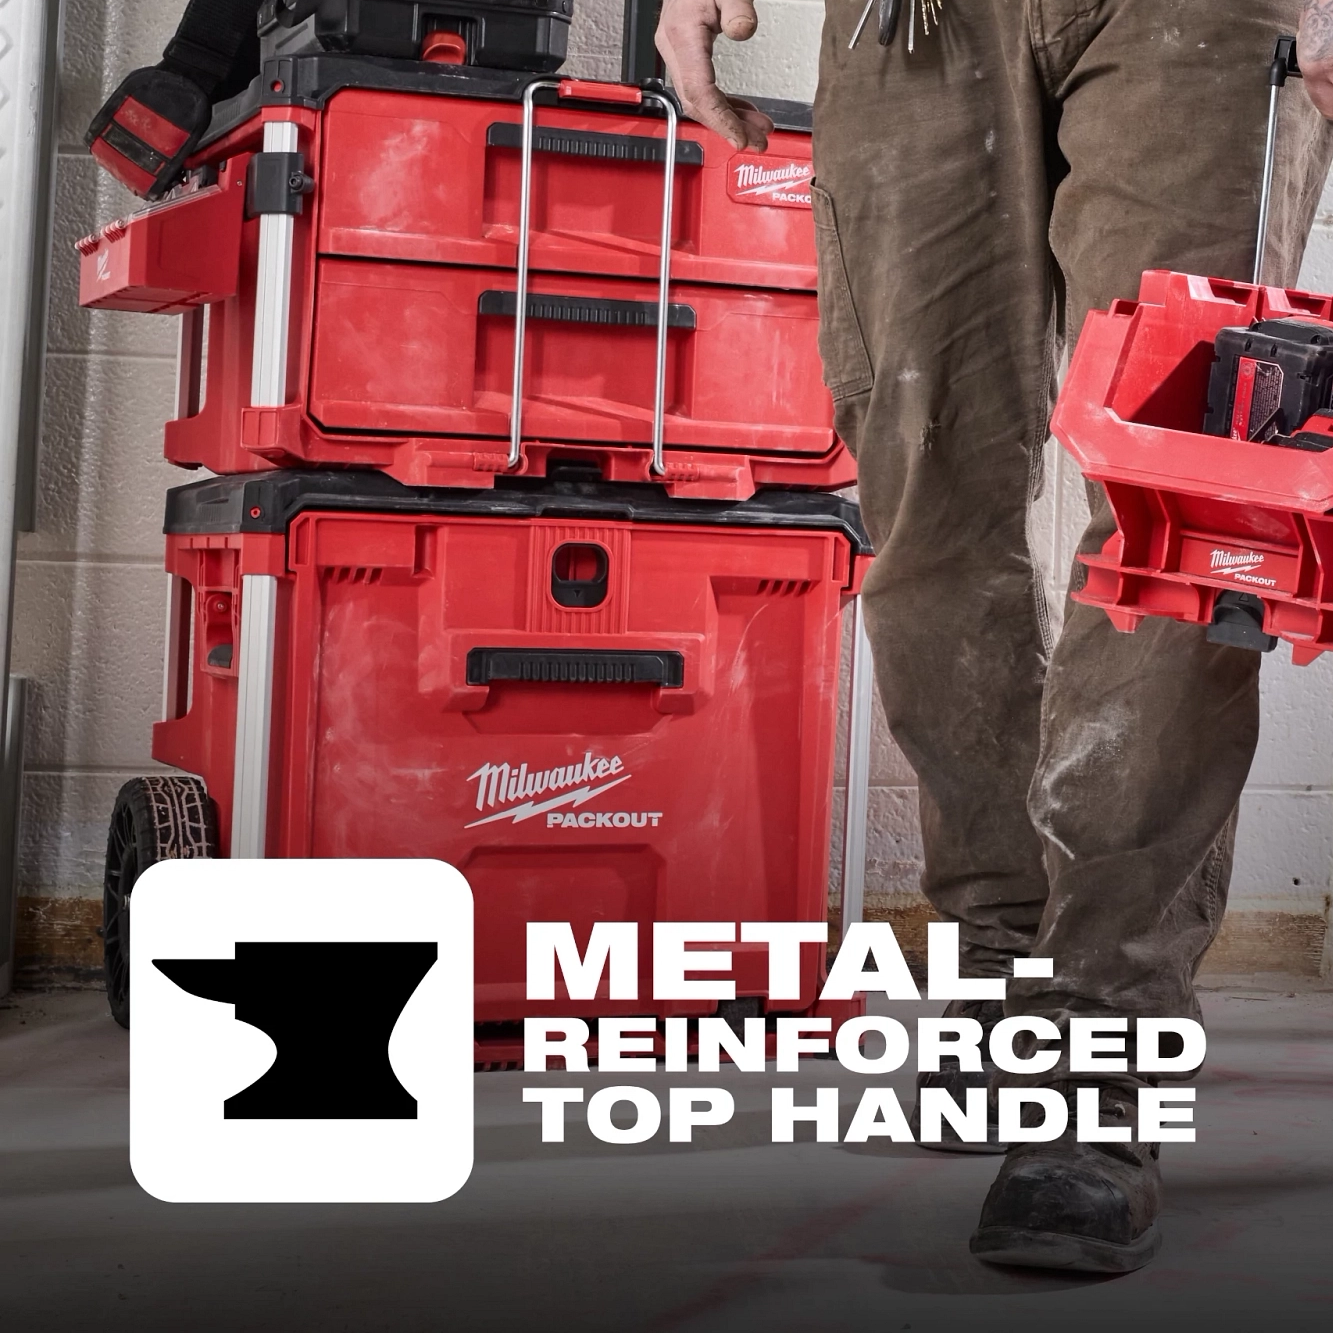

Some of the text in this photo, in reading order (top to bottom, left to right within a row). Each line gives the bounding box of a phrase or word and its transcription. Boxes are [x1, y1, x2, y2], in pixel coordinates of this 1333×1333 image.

[733, 163, 811, 189] Milwaukee
[1210, 549, 1265, 568] Milwaukee
[1234, 573, 1277, 587] PACKOUT
[466, 751, 625, 812] Milwaukee
[546, 812, 663, 828] PACKOUT
